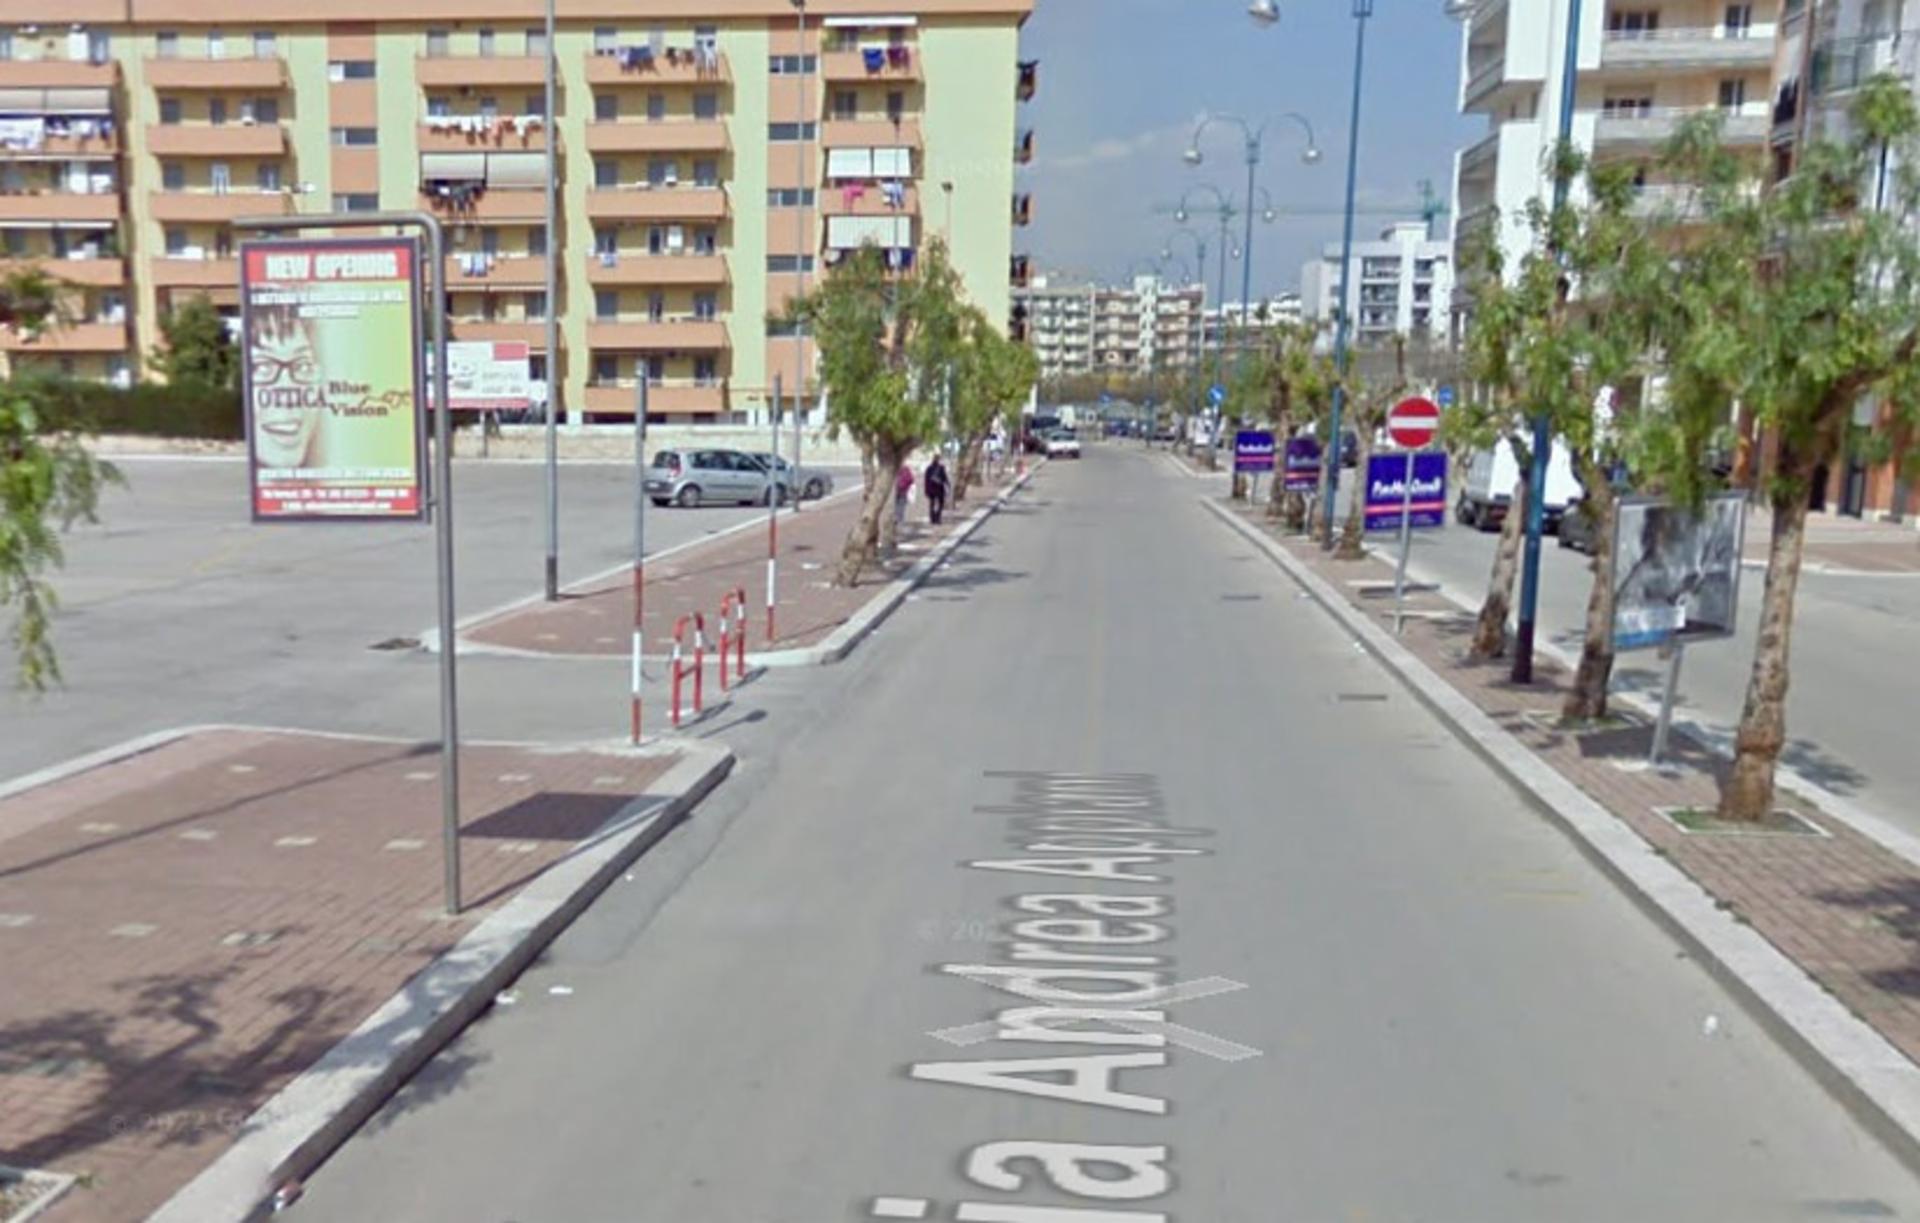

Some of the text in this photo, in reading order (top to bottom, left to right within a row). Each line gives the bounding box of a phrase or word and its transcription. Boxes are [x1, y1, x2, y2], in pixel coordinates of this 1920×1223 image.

[265, 252, 398, 279] NEW OPENING
[328, 380, 371, 394] Blue
[258, 387, 328, 409] OTTICA
[328, 402, 389, 417] Vision
